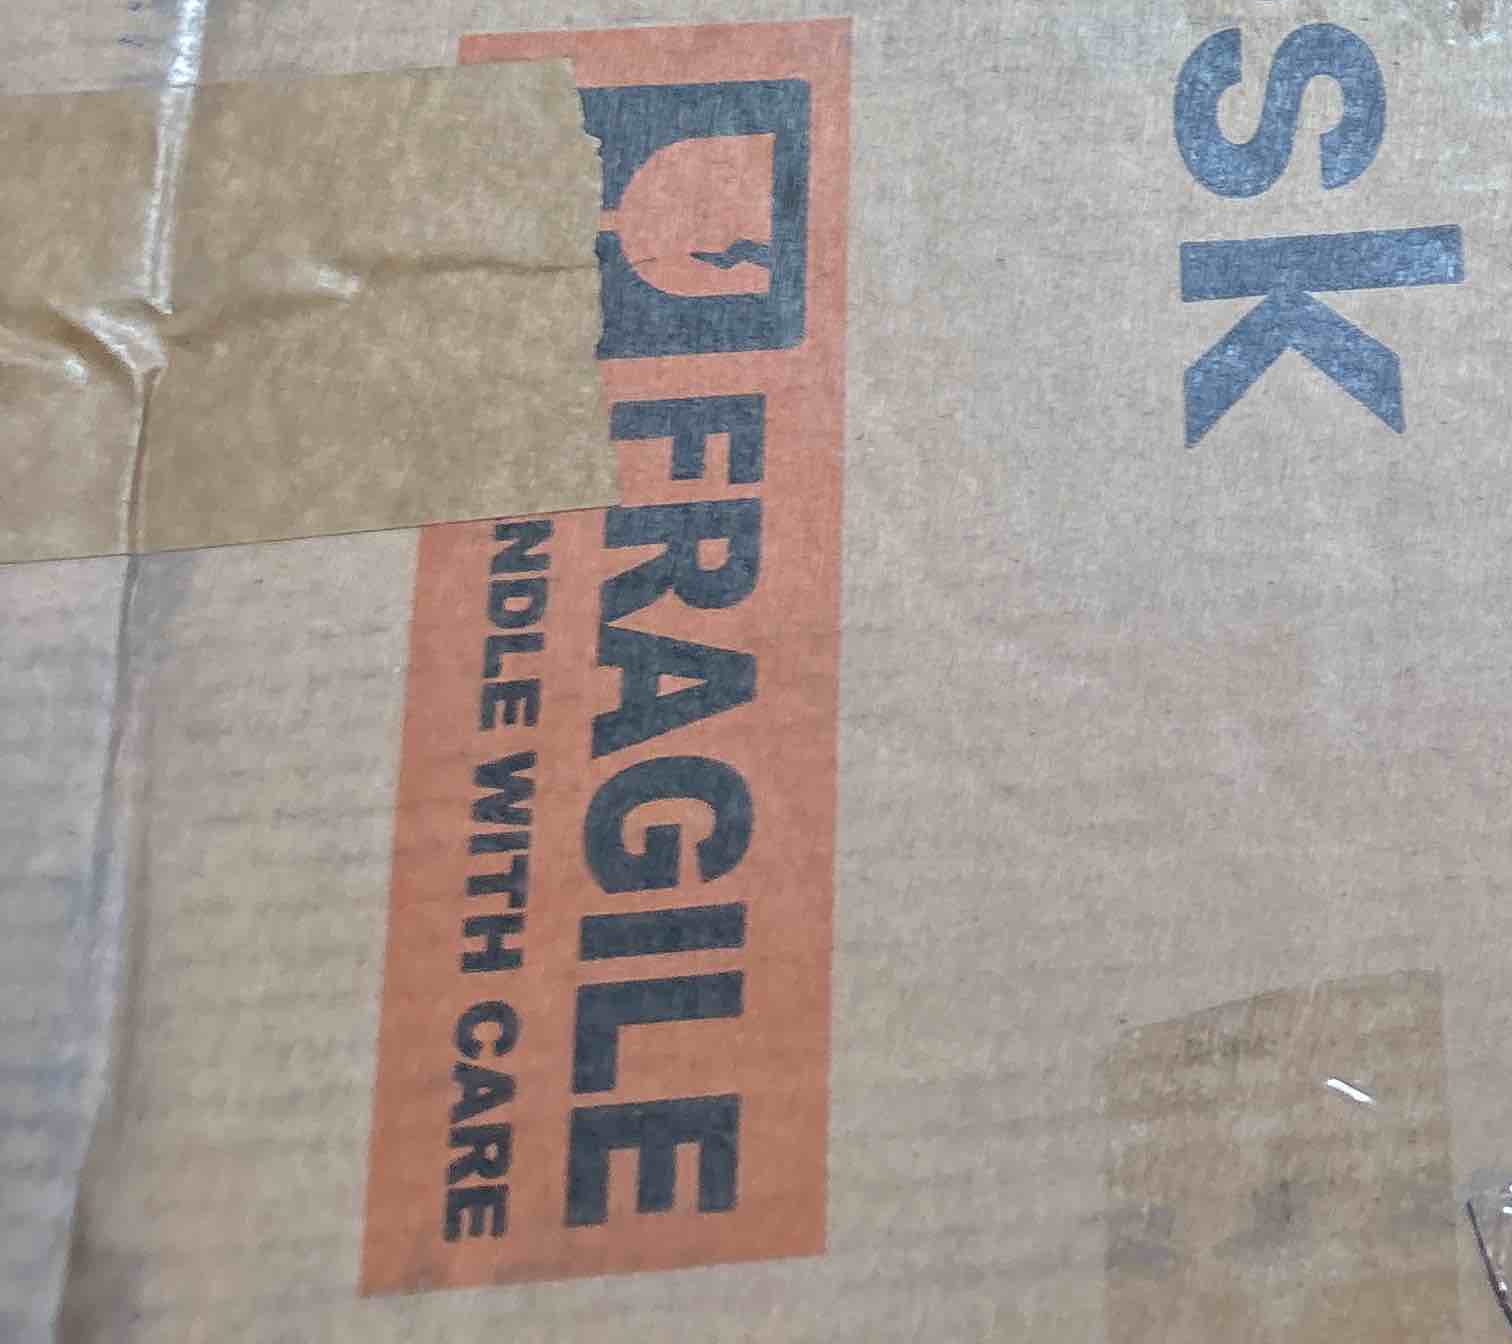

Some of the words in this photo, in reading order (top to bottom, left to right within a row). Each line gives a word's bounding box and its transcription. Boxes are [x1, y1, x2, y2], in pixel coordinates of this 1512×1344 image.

[477, 519, 555, 733] NDLE
[459, 750, 540, 975] WITH
[564, 393, 768, 1229] FRAGILE
[440, 997, 526, 1244] CARE
